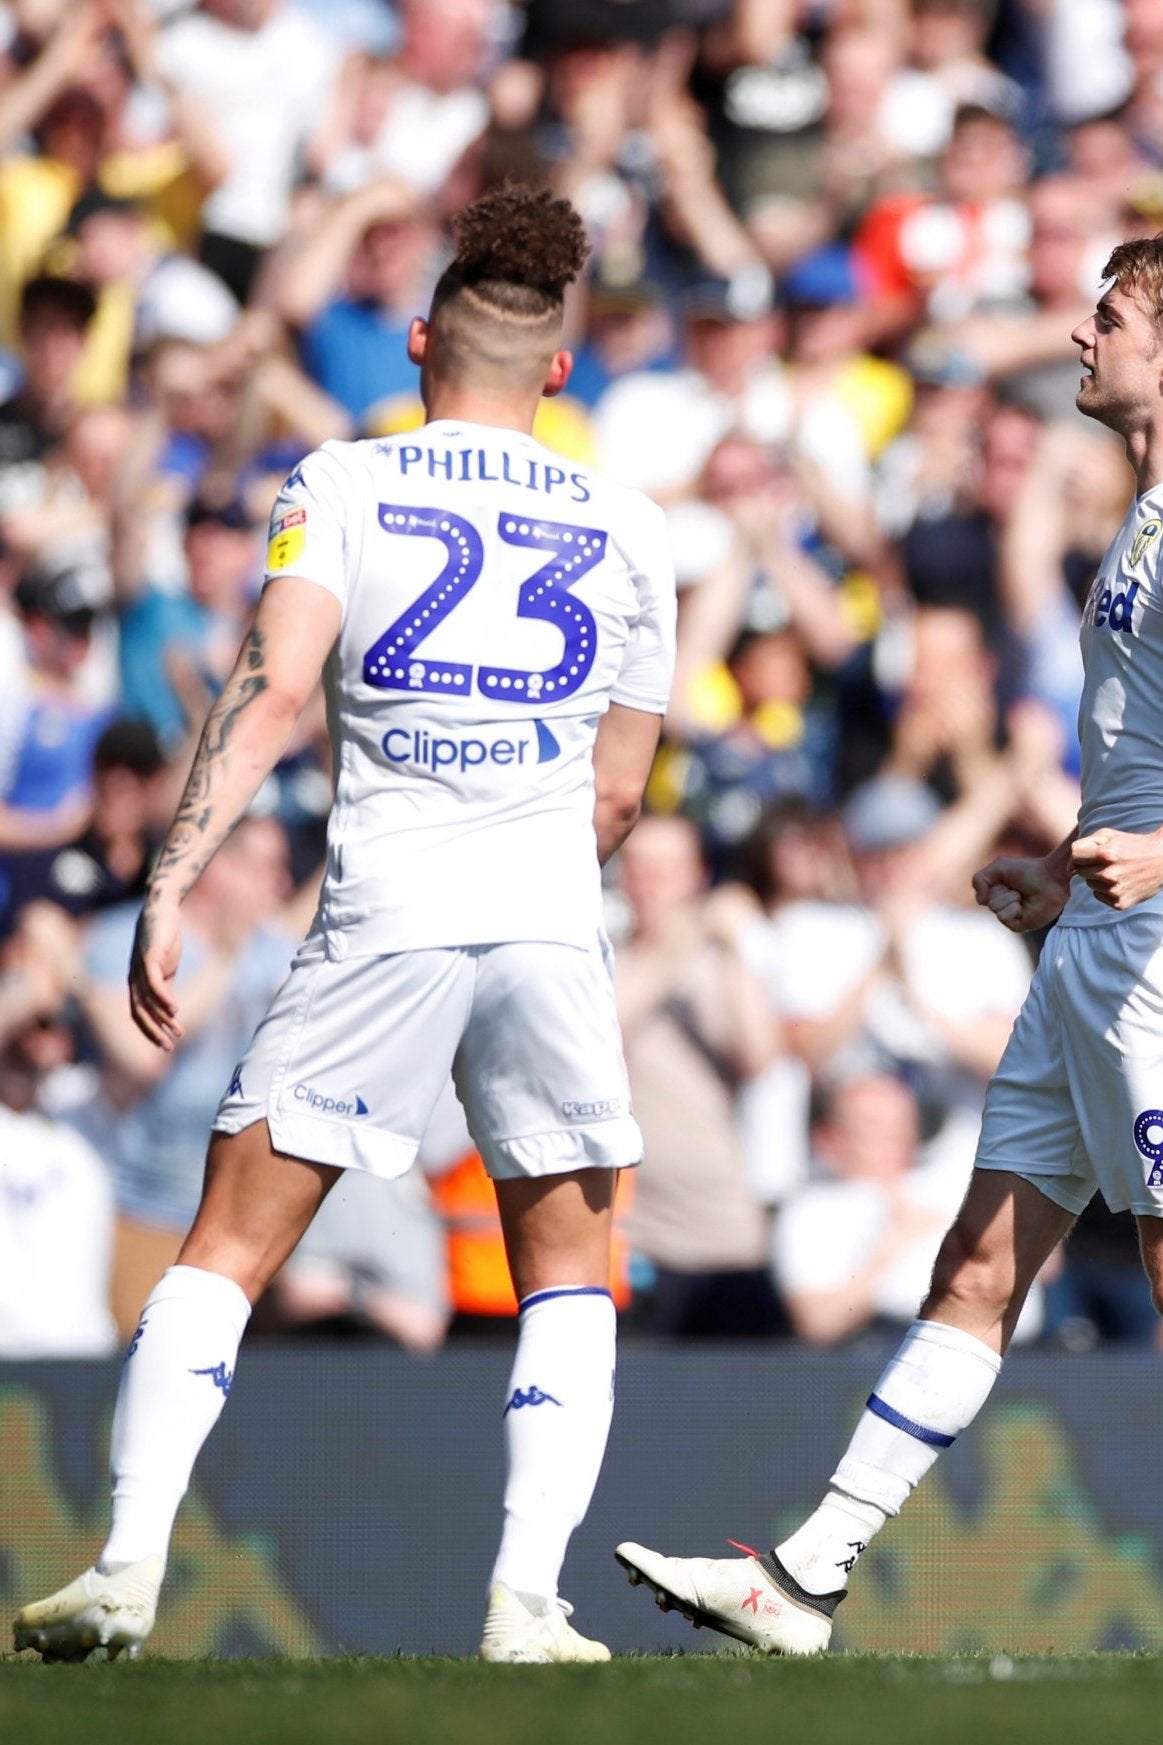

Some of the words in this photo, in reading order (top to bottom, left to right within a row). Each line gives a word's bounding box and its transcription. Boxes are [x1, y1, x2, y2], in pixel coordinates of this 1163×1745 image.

[399, 445, 591, 503] PHILLIPS
[363, 502, 608, 704] 23
[382, 728, 529, 773] Clipper
[293, 1083, 353, 1115] Clipper
